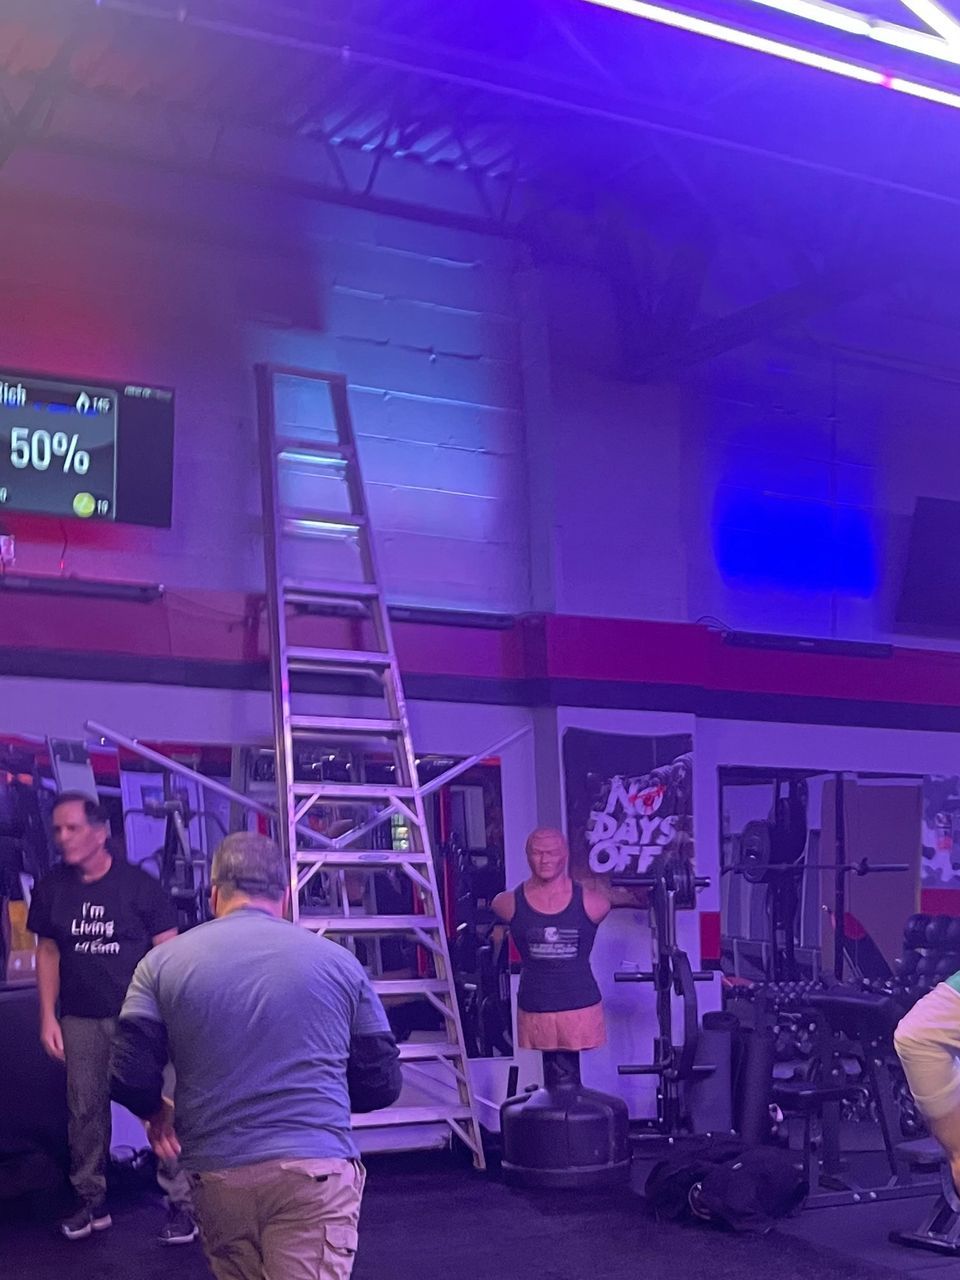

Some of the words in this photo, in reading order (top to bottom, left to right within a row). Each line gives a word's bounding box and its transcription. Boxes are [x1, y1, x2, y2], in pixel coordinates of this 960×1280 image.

[11, 427, 90, 475] 50%
[604, 774, 667, 816] NO
[585, 811, 679, 846] DAYS
[589, 839, 663, 873] OFF
[82, 902, 105, 919] I'm
[71, 919, 115, 938] Living
